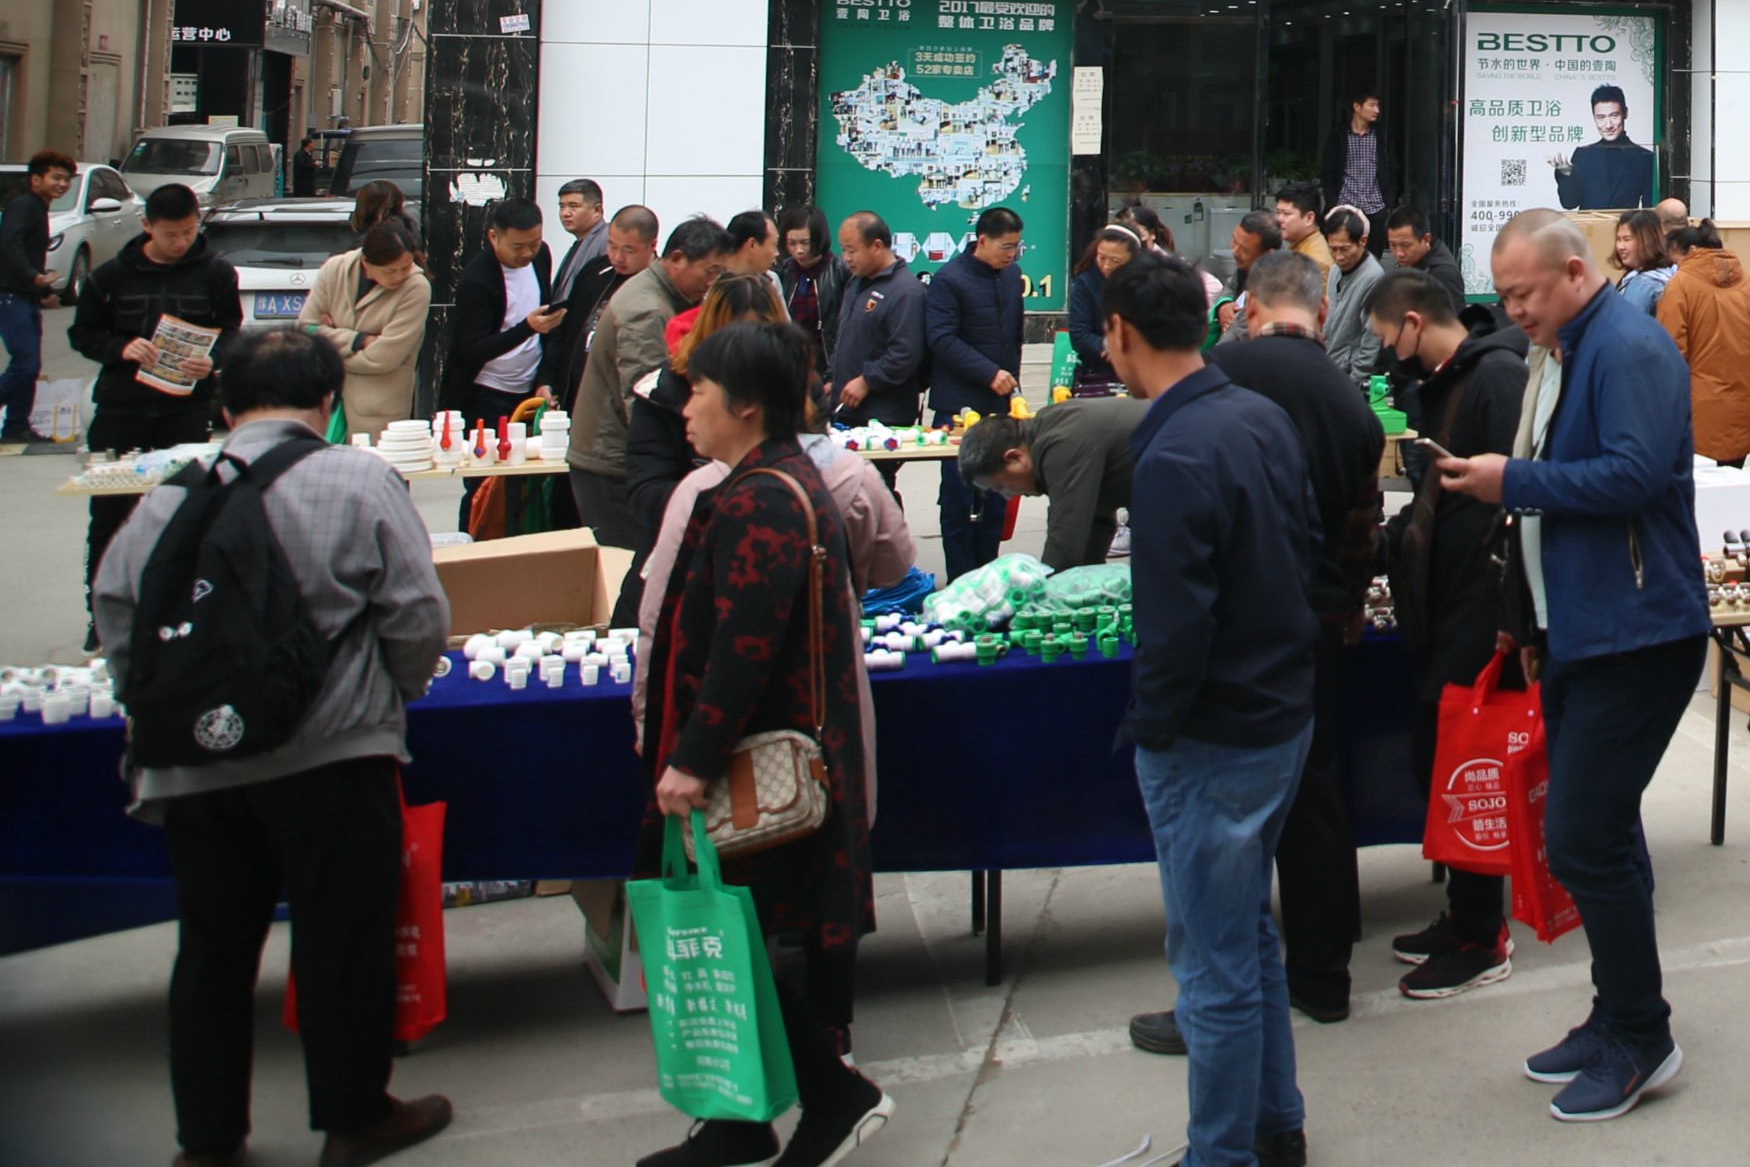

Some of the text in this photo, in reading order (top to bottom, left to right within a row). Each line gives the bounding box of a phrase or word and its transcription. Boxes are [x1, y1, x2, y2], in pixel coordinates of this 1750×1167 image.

[938, 0, 1055, 17] 2017最受欢迎的
[937, 15, 1055, 32] 整体卫浴品牌
[1477, 32, 1616, 54] BESTTO
[914, 51, 976, 64] 3天成功签约
[916, 63, 975, 76] 52家专卖店
[1469, 98, 1562, 117] 高品质卫浴
[1492, 124, 1584, 143] 创新型品牌
[1464, 767, 1500, 783] 尚品质
[1467, 796, 1508, 812] SOJO
